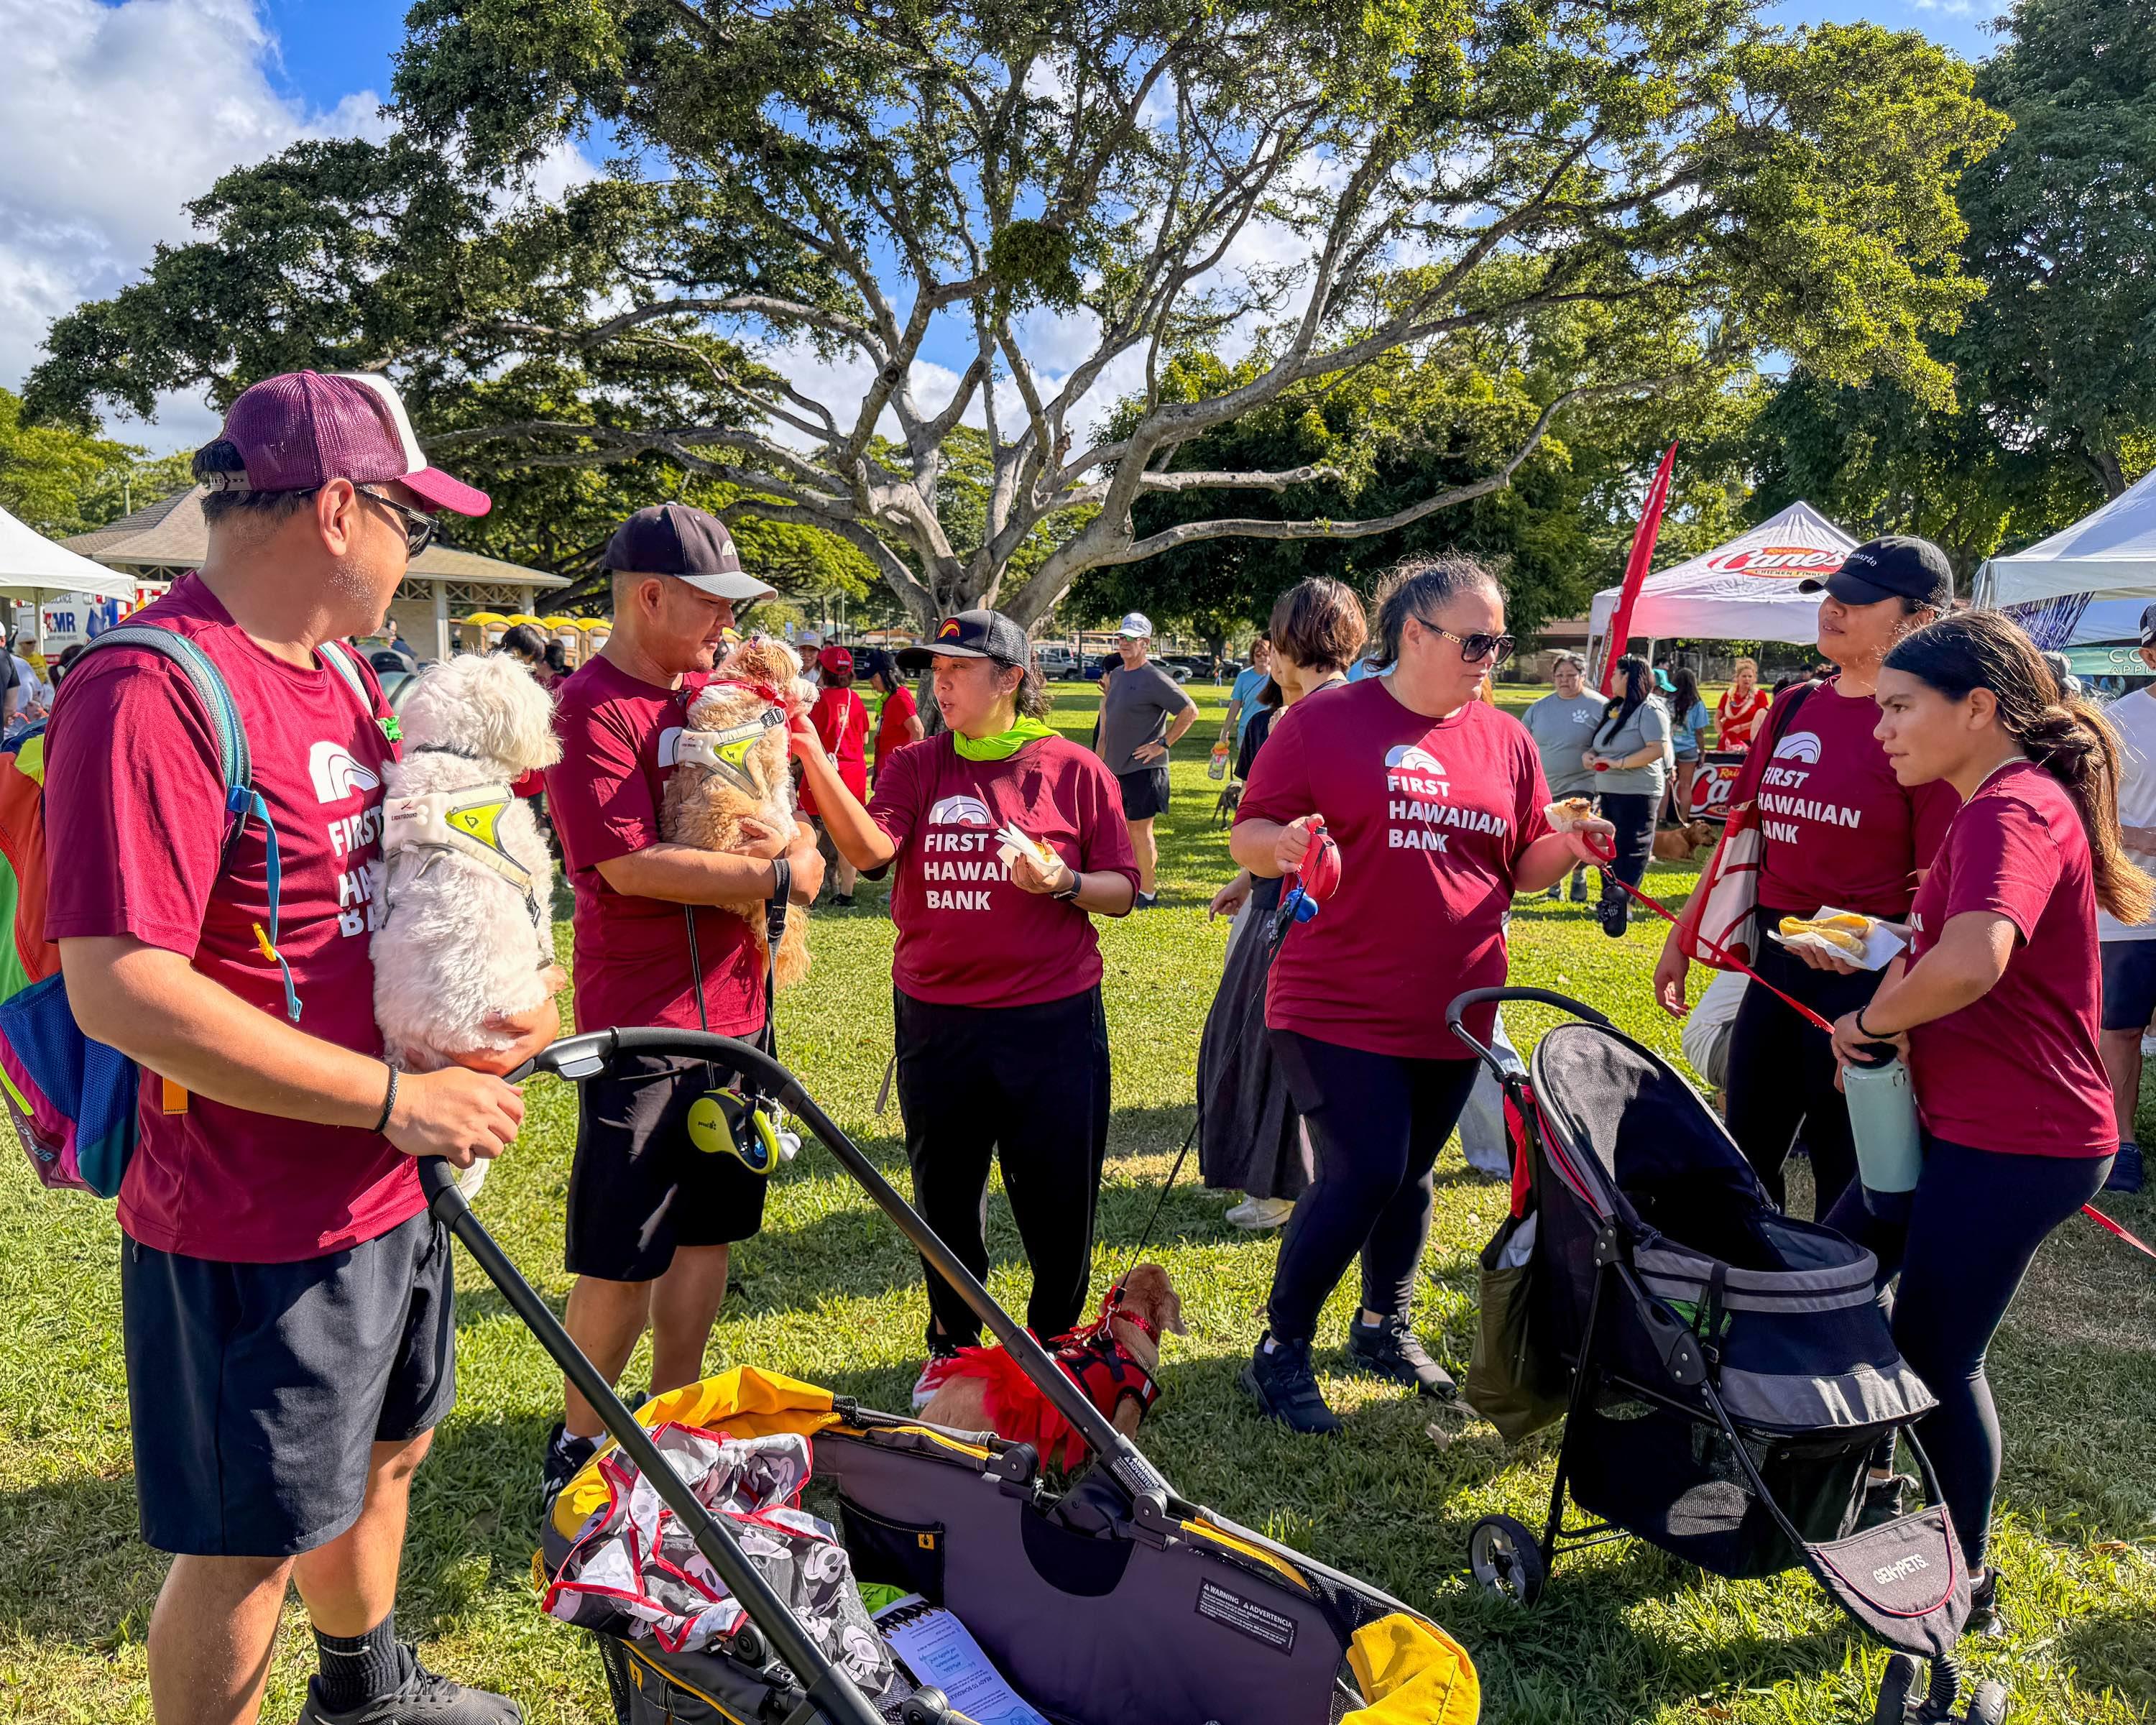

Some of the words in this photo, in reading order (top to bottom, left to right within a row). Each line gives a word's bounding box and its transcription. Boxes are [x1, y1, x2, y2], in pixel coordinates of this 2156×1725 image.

[1442, 632, 1460, 643] GUCCI
[1387, 776, 1450, 797] FIRST
[1761, 767, 1810, 788] FIRST
[1389, 801, 1507, 837] HAWAIIAN
[1758, 792, 1861, 829] HAWAIIAN
[328, 805, 382, 857] FIRST
[924, 833, 989, 852] FIRST
[1388, 829, 1449, 852] BANK
[1762, 819, 1800, 844] ANK
[926, 890, 991, 911] BANK
[1137, 1460, 1160, 1488] WARNING
[1210, 1585, 1239, 1604] WARNING
[1250, 1605, 1292, 1628] ADVERTENCIA
